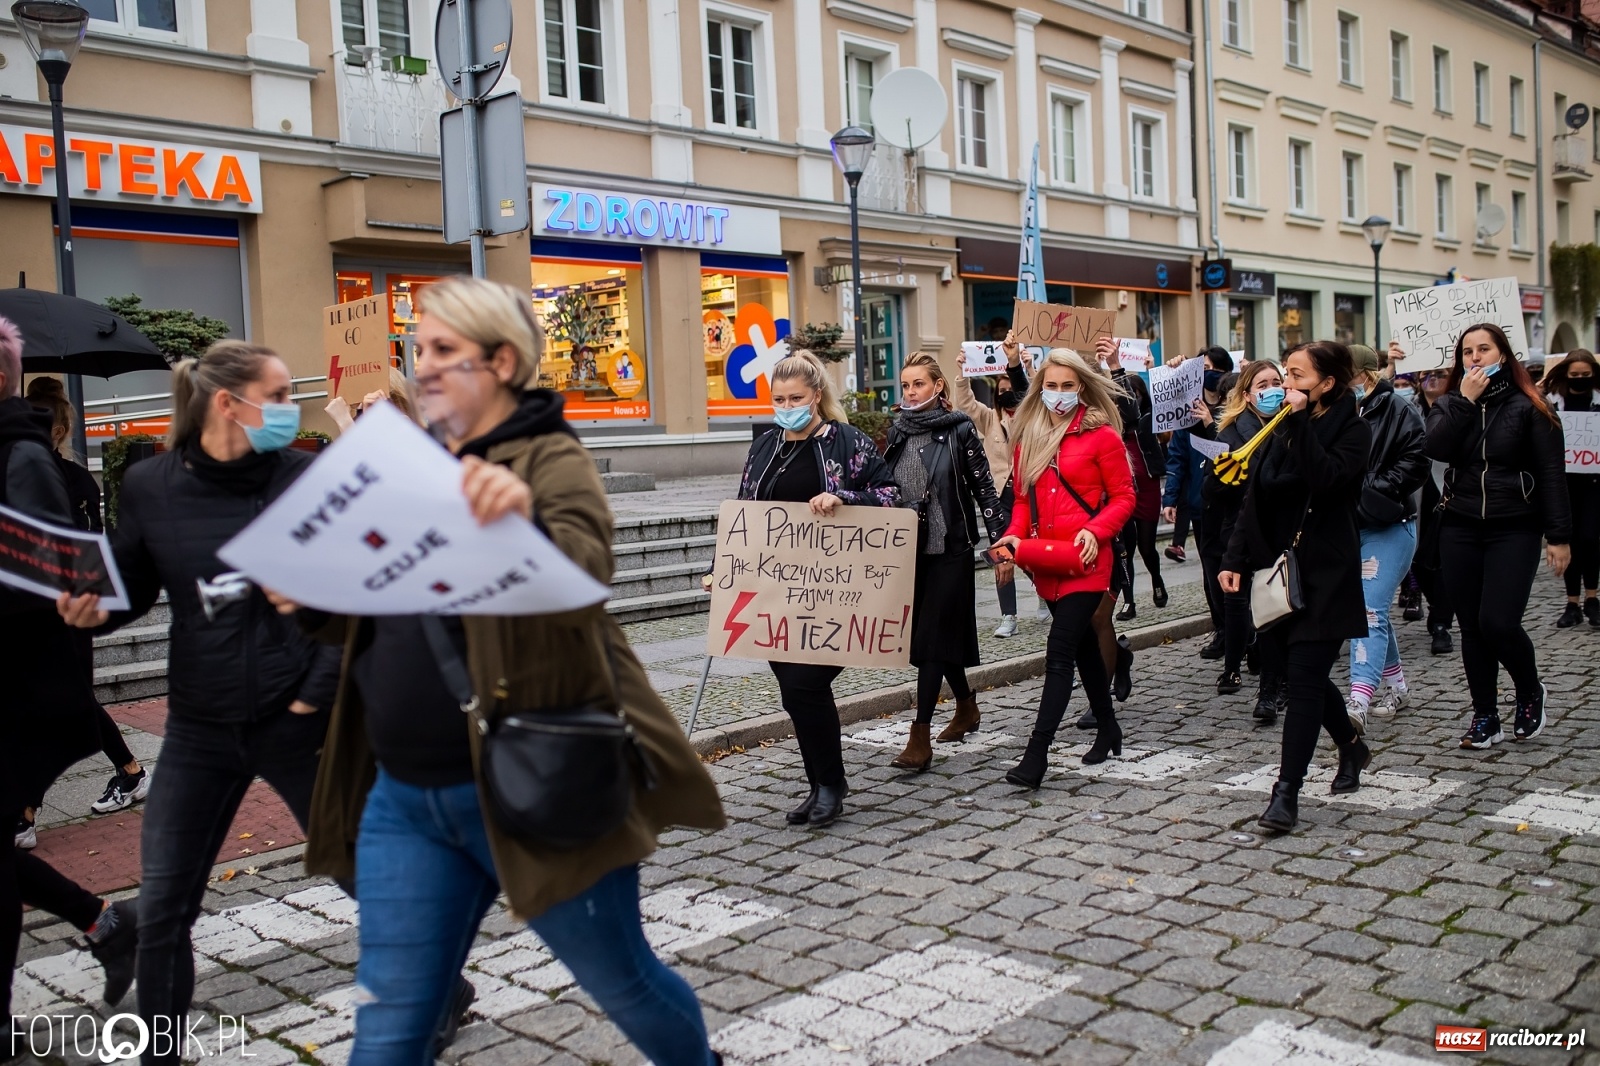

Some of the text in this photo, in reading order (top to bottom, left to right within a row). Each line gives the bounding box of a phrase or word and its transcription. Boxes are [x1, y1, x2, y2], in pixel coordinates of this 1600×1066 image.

[547, 189, 729, 243] ZDROWIT
[65, 241, 71, 251] 4
[1394, 290, 1438, 314] MARS
[1448, 288, 1466, 301] OD
[1419, 300, 1497, 322] TO SRAM
[345, 327, 361, 345] GO
[1392, 329, 1400, 341] A
[1403, 324, 1428, 339] PIS
[1440, 320, 1460, 332] OD
[1407, 333, 1441, 357] JEST
[1152, 374, 1189, 394] KOCHAM
[1154, 377, 1201, 404] ROZUMIEM
[614, 406, 646, 415] Nowa 3-5
[1157, 422, 1173, 431] NIE
[726, 507, 910, 556] A PAMIĘTACIE
[719, 554, 753, 589] JAK
[757, 552, 852, 586] KACZYŃSKI
[786, 587, 834, 611] FAJNY
[754, 605, 911, 654] JA TEŻ NIE!
